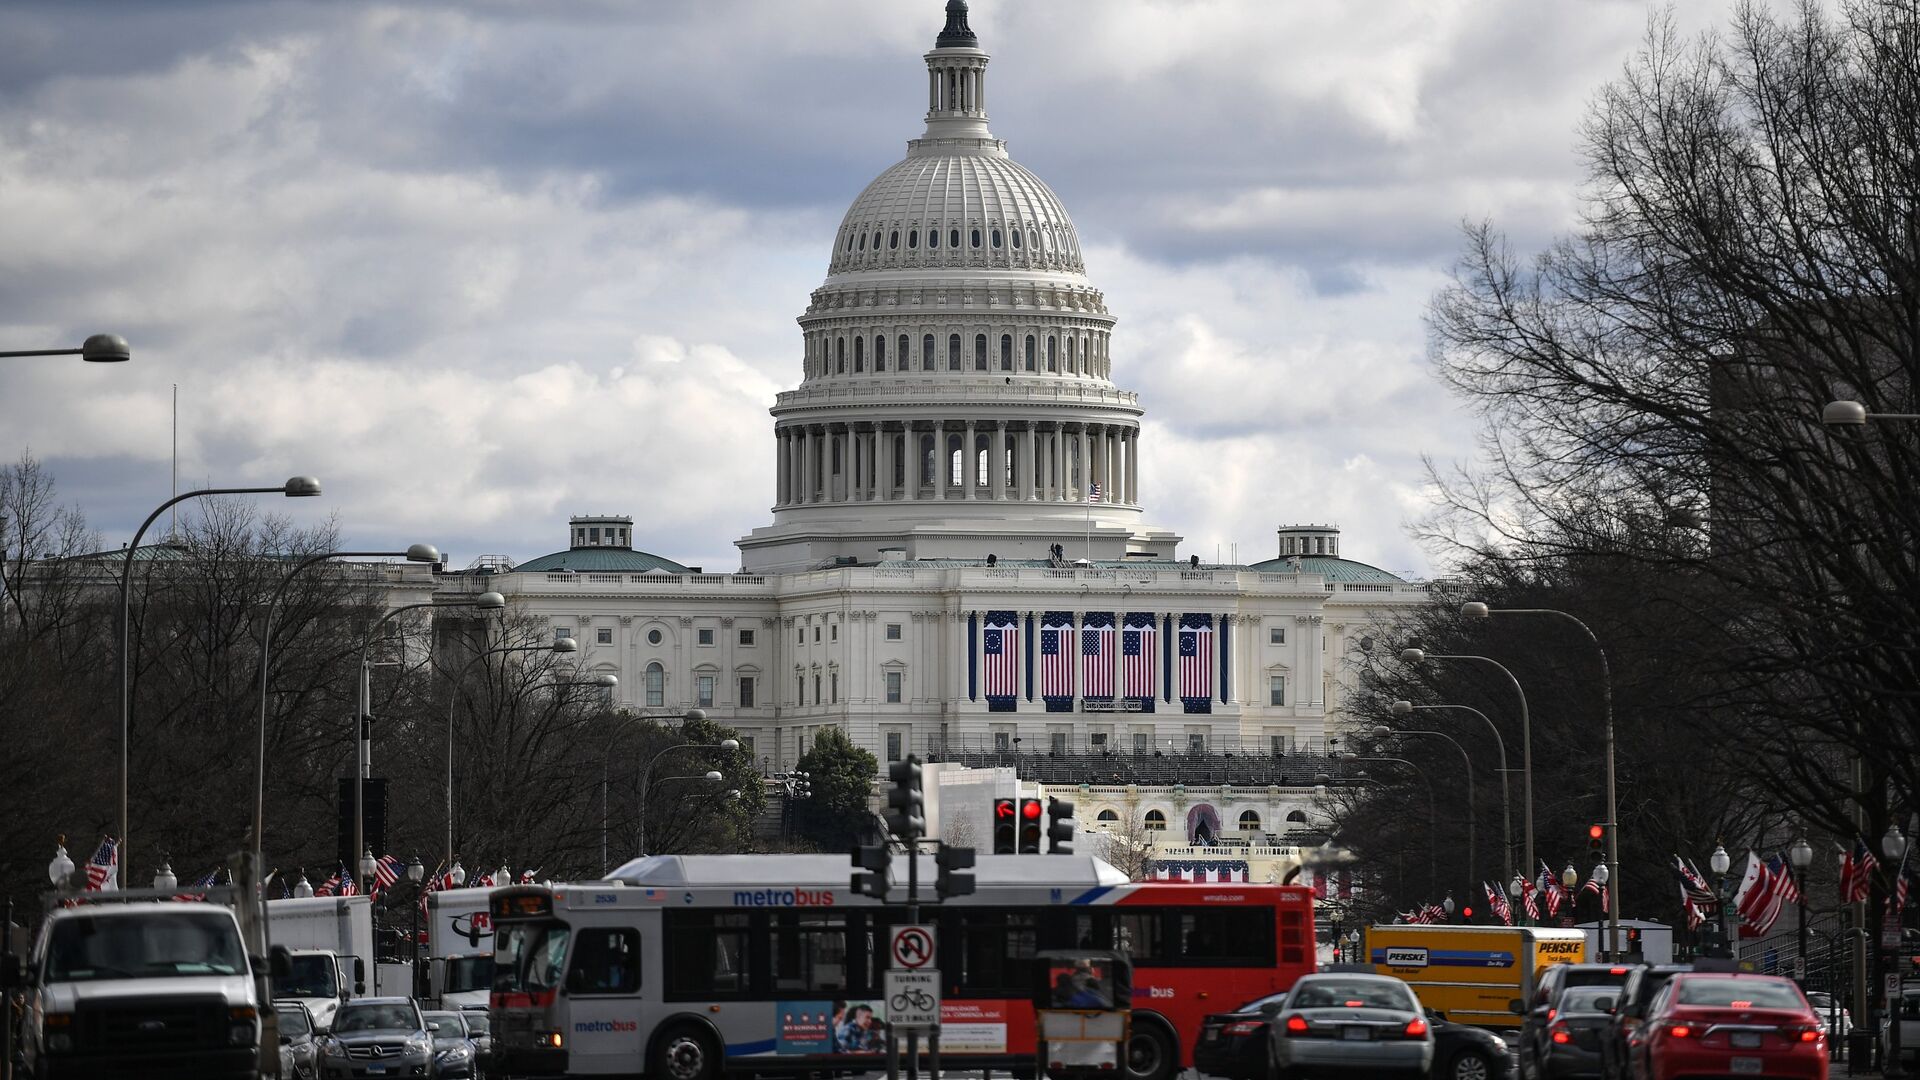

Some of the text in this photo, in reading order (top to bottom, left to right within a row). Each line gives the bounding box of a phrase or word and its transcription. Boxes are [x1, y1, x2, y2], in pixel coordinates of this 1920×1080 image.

[734, 887, 834, 905] metrobus
[1539, 943, 1580, 953] PENSKE
[1388, 953, 1426, 961] PENSKE
[895, 975, 932, 983] TURNING
[575, 1019, 637, 1032] metrobus
